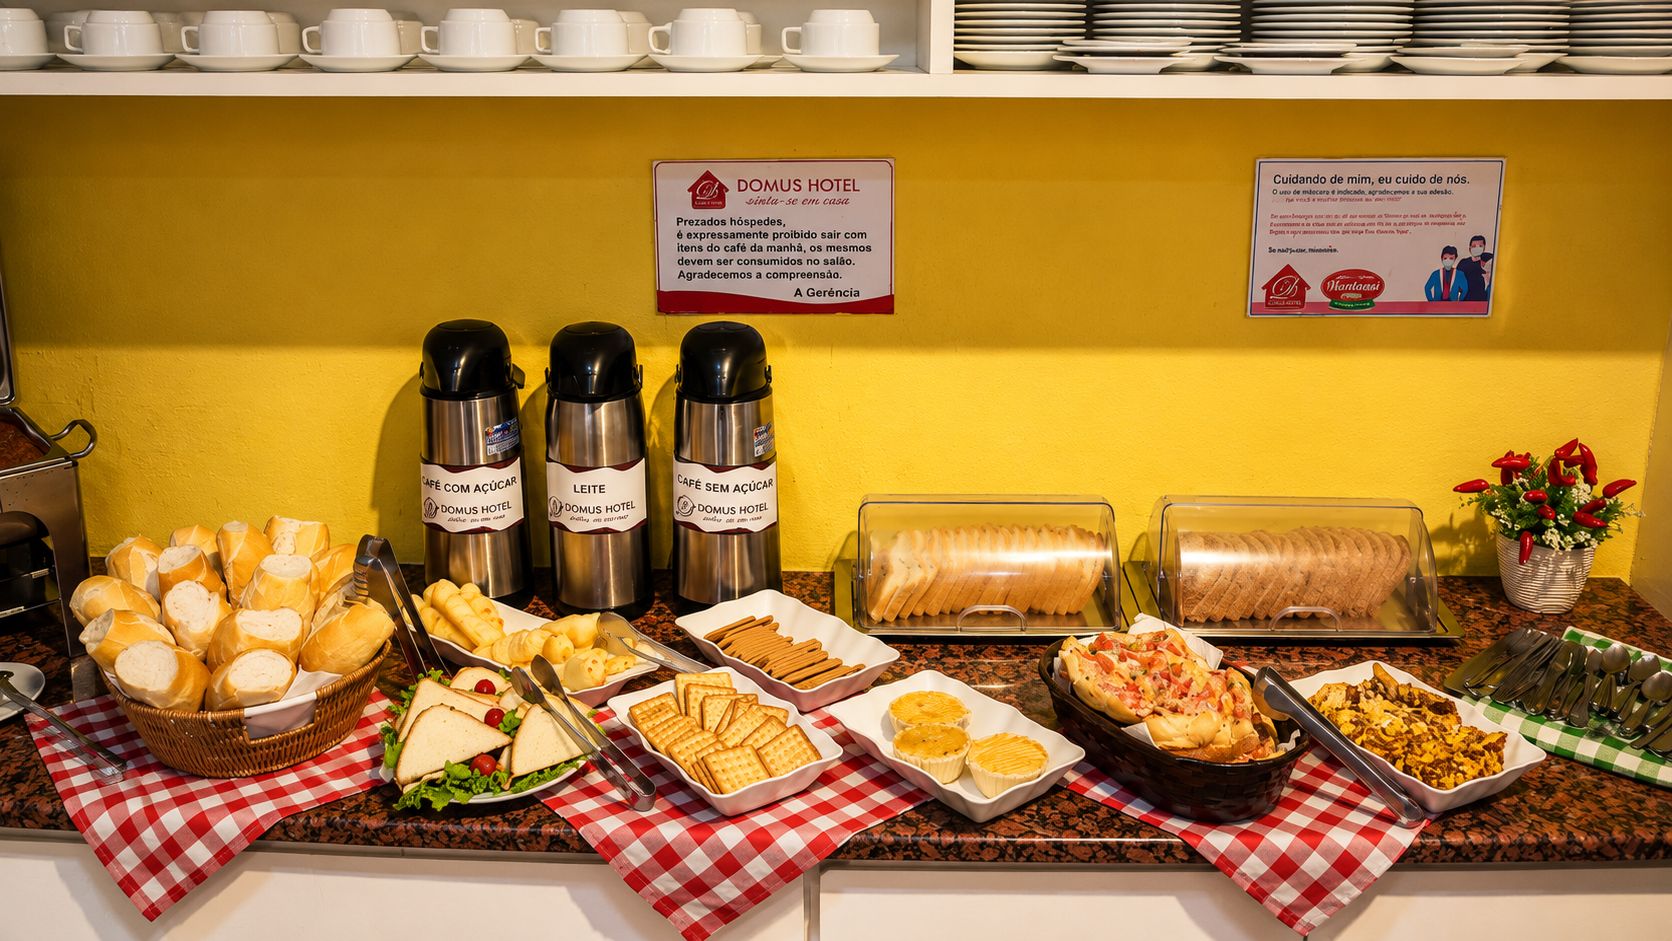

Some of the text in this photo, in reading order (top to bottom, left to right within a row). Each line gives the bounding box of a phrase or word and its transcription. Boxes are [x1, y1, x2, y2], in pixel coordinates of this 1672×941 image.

[737, 178, 860, 193] DOMUS HOTEL
[1273, 173, 1470, 187] Cuidando de mim, eu cuido de nós.
[801, 198, 820, 206] em
[823, 197, 850, 206] casa
[676, 216, 786, 229] Prezados hóspedes,
[676, 229, 868, 241] é expressamente proibido sair com
[677, 243, 704, 253] itens
[706, 243, 721, 253] do
[723, 243, 747, 253] café
[750, 243, 764, 253] da
[809, 244, 823, 253] os
[826, 245, 872, 253] mesmos
[677, 256, 714, 267] devem
[716, 258, 734, 267] ser
[736, 256, 804, 266] consumidos
[806, 258, 820, 266] no
[677, 270, 752, 282] Agradecemos
[755, 272, 763, 280] a
[793, 287, 803, 298] A
[422, 476, 517, 494] CAFÉ COM AÇÚCAR
[573, 484, 606, 494] LEITE
[677, 474, 774, 494] CAFÉ SEM AÇÚCAR
[441, 501, 512, 515] DOMUS HOTEL
[565, 501, 636, 514] DOMUS HOTEL
[697, 502, 769, 515] DOMUS HOTEL
